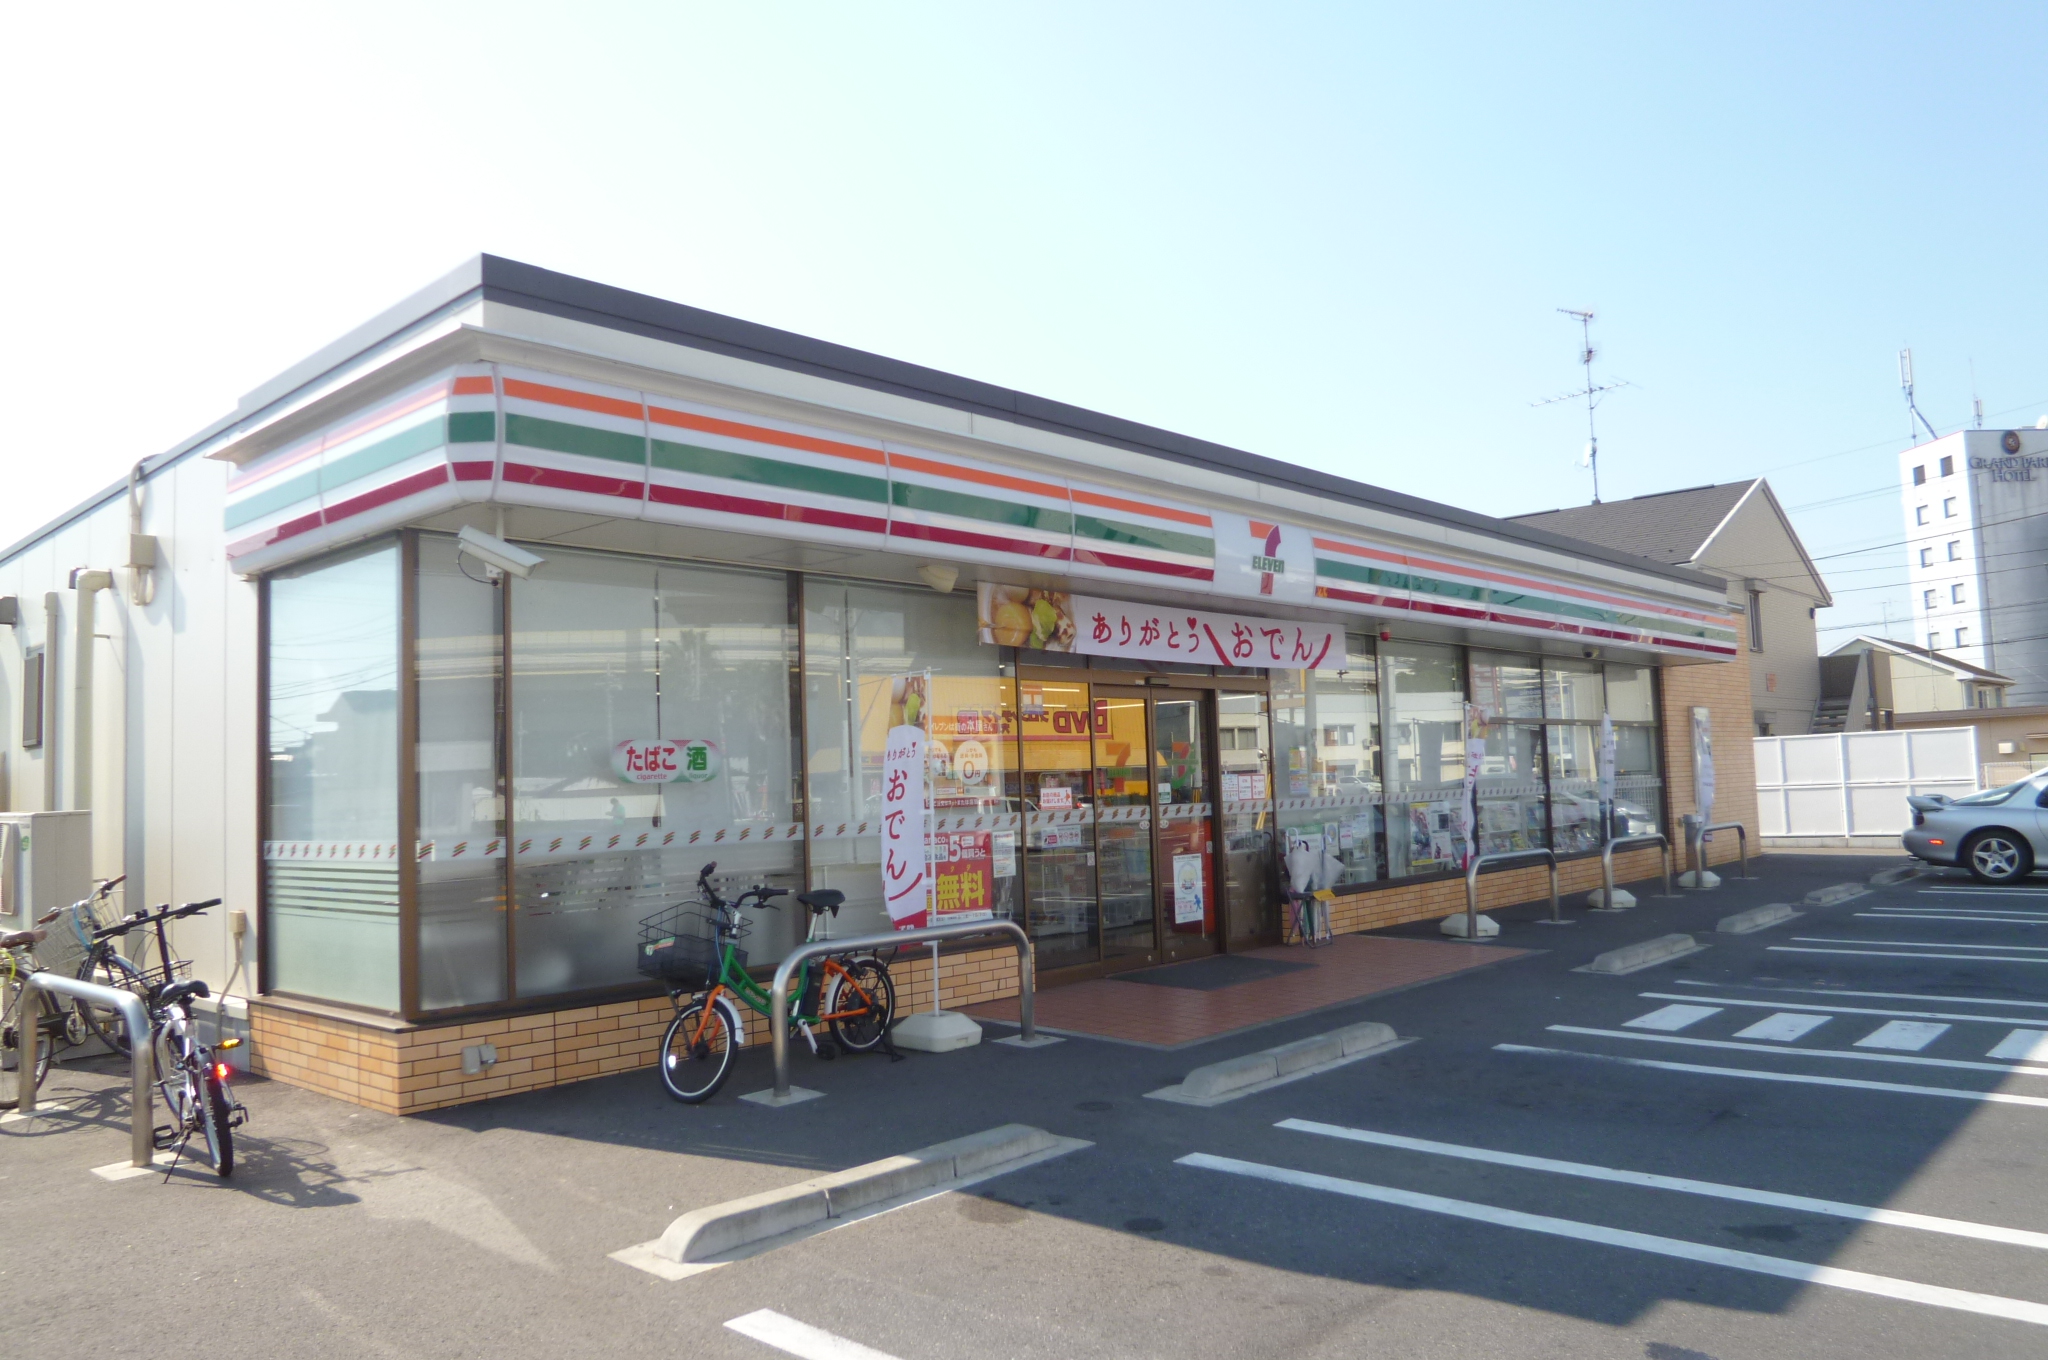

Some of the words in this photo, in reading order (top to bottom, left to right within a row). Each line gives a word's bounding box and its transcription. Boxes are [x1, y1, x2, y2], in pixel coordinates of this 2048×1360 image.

[1969, 456, 2018, 469] GRAND
[1992, 469, 2037, 482] HOTEL
[1091, 612, 1200, 654] ありがとう
[1231, 621, 1313, 662] おでん
[626, 745, 677, 772] たばこ
[686, 746, 707, 771] 酒
[636, 773, 668, 781] cigarette
[885, 768, 908, 880] おでん
[949, 835, 962, 862] 5
[936, 869, 985, 911] 無料
